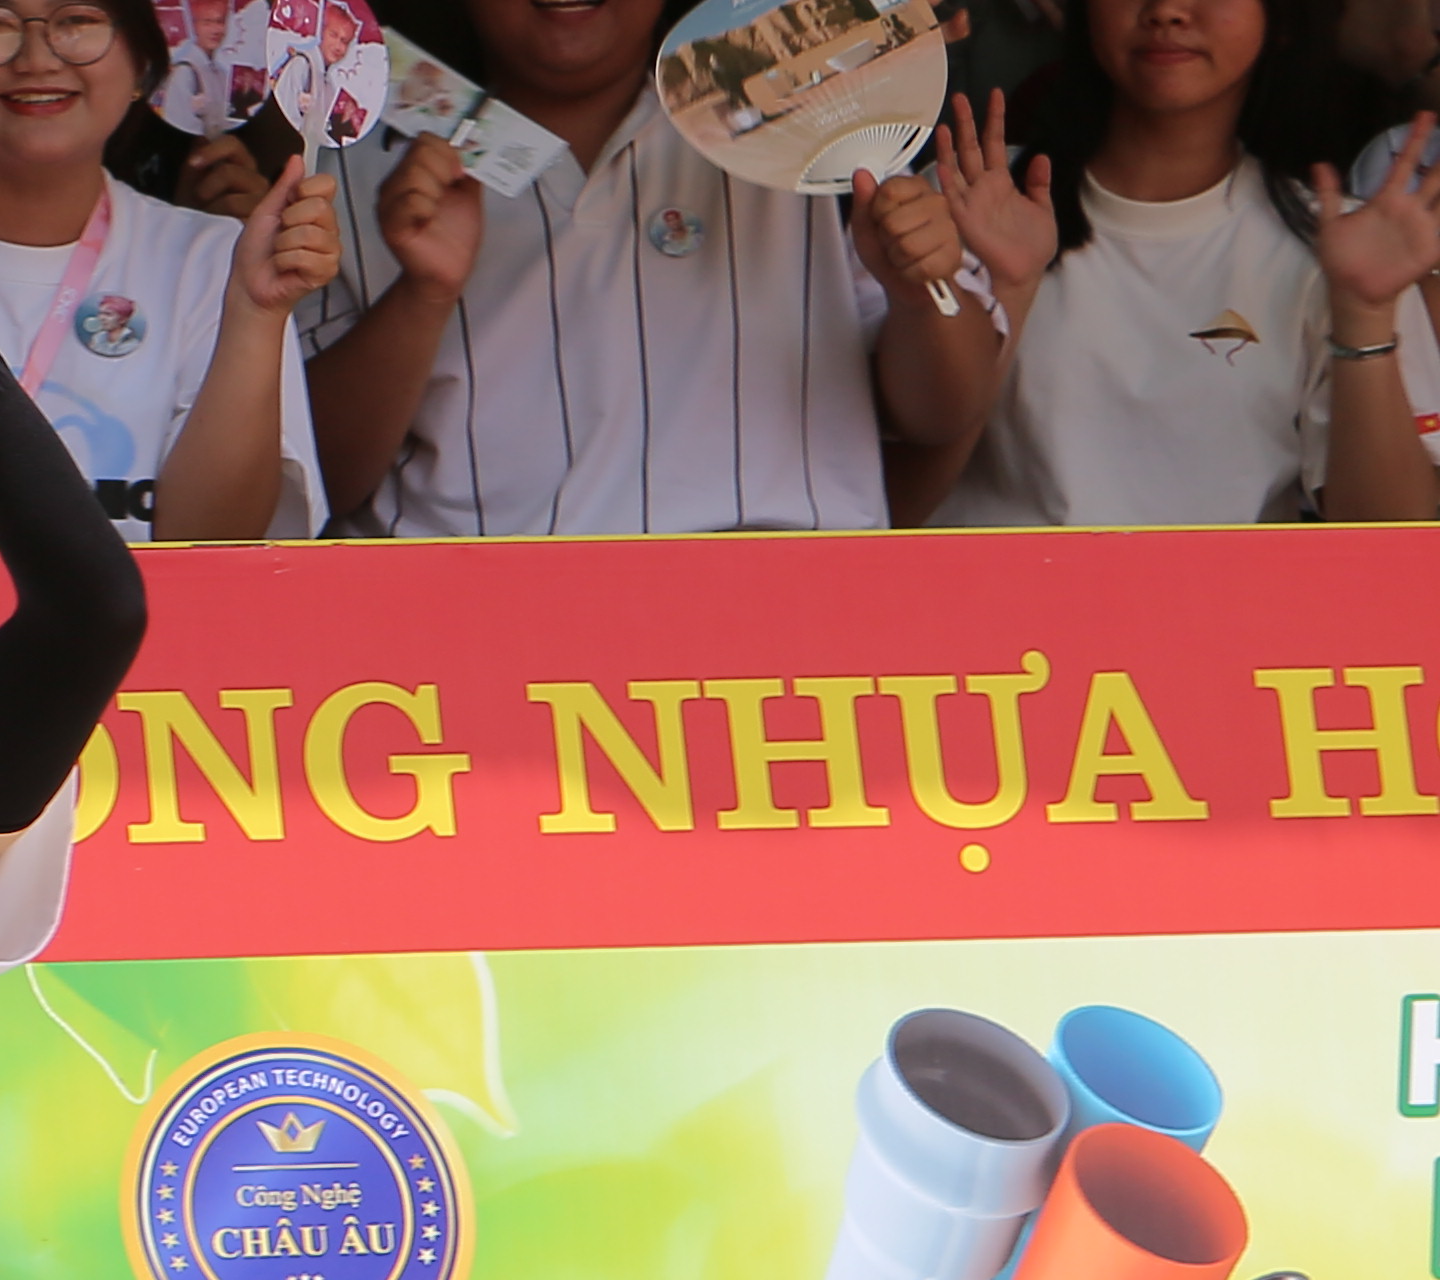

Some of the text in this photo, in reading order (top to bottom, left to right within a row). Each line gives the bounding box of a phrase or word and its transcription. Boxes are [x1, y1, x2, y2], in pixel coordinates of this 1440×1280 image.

[68, 678, 471, 846] NG
[526, 650, 1209, 873] NHỰA
[171, 1067, 411, 1148] EUROPEAN TECHNOLOGY
[234, 1181, 363, 1212] Công Nghệ
[210, 1214, 398, 1259] CHÂU ÂU
